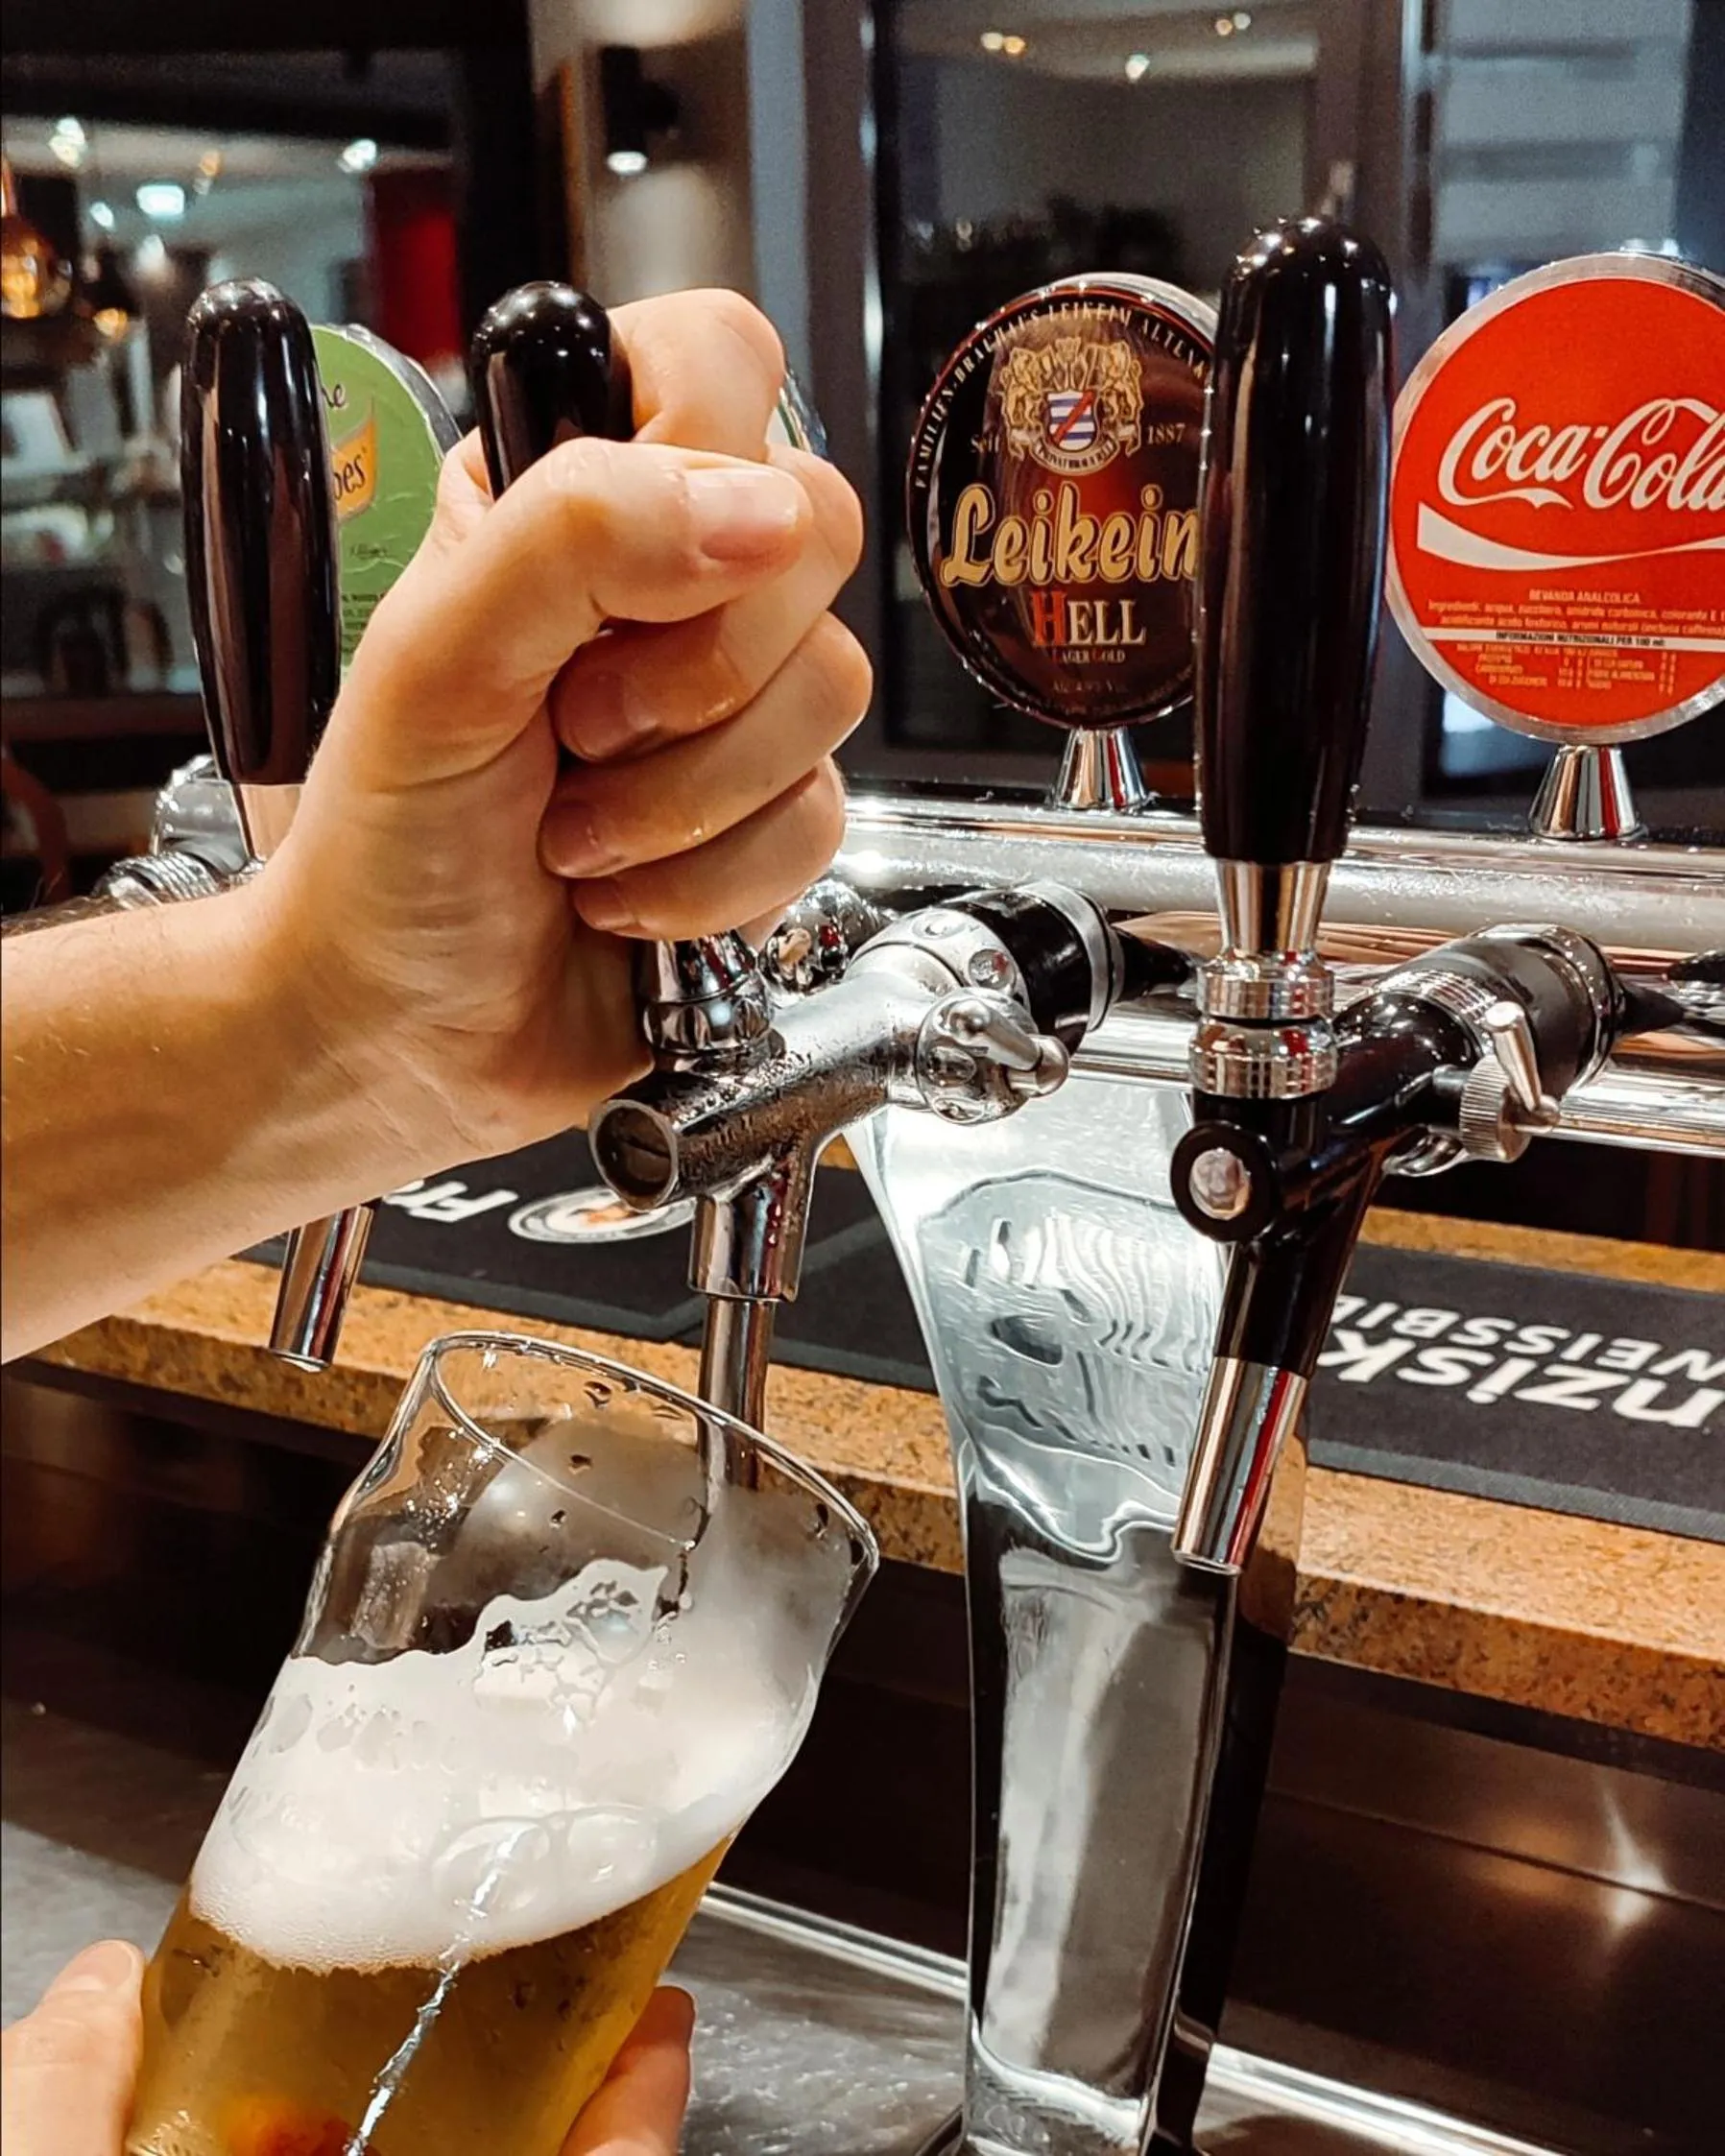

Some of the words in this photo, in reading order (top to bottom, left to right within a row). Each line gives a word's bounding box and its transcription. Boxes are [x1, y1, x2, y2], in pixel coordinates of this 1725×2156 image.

[1147, 422, 1186, 445] 1887
[1438, 396, 1725, 511] Coca-Cola
[1030, 590, 1147, 648] HELL
